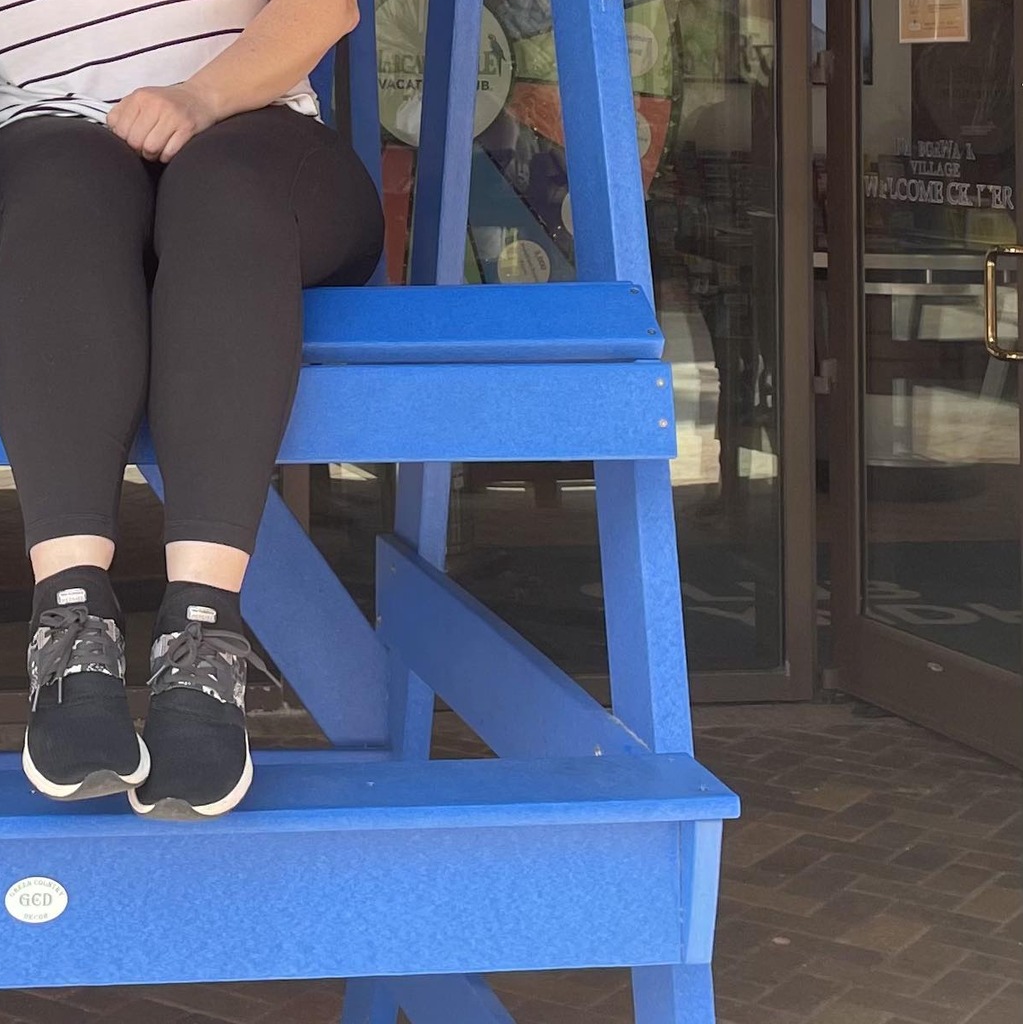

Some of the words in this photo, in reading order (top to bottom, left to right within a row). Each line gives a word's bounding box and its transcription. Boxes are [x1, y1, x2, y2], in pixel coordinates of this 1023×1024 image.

[910, 160, 961, 177] VILLAGE
[864, 175, 944, 204] WELCOME
[19, 892, 53, 906] GCD
